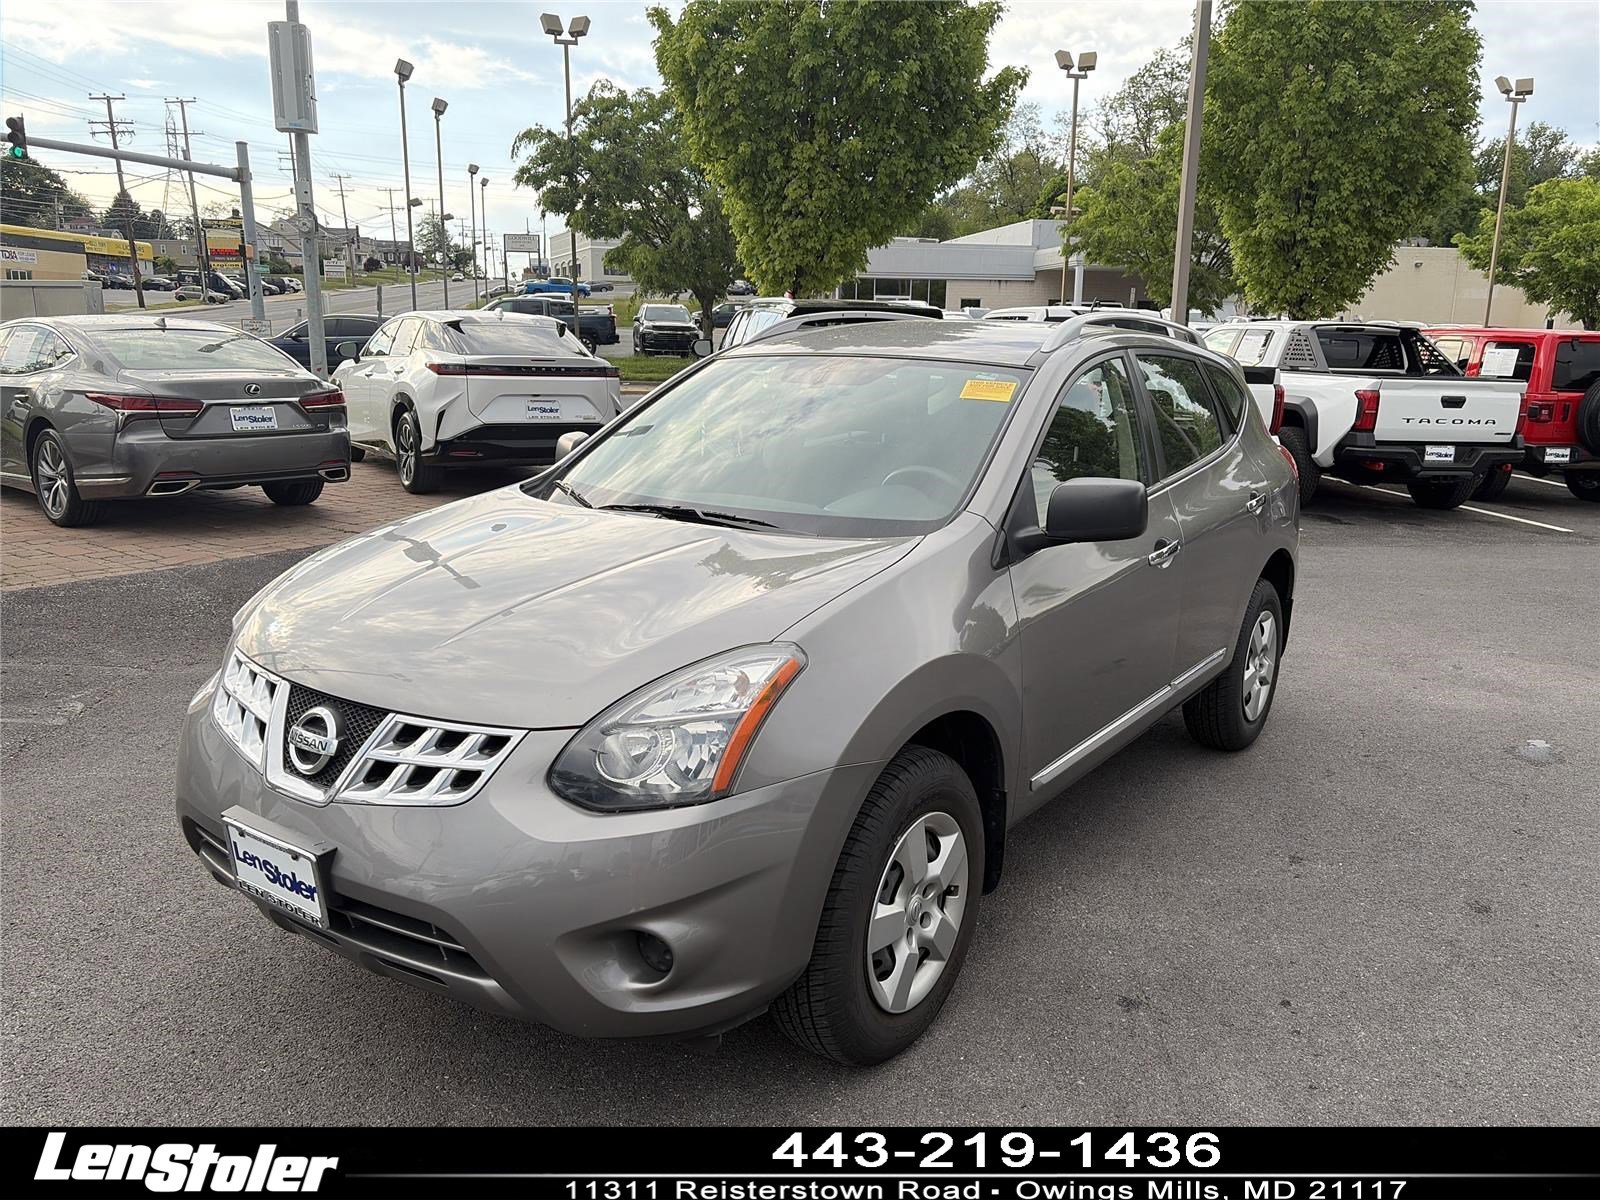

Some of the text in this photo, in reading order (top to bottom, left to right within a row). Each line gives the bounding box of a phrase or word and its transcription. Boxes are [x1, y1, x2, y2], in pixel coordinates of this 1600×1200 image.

[233, 414, 273, 424] LenStoler
[1402, 417, 1497, 425] TACOMA
[290, 729, 329, 752] NISSAN
[232, 840, 318, 903] LenStoler
[239, 881, 322, 928] LEN STOLER
